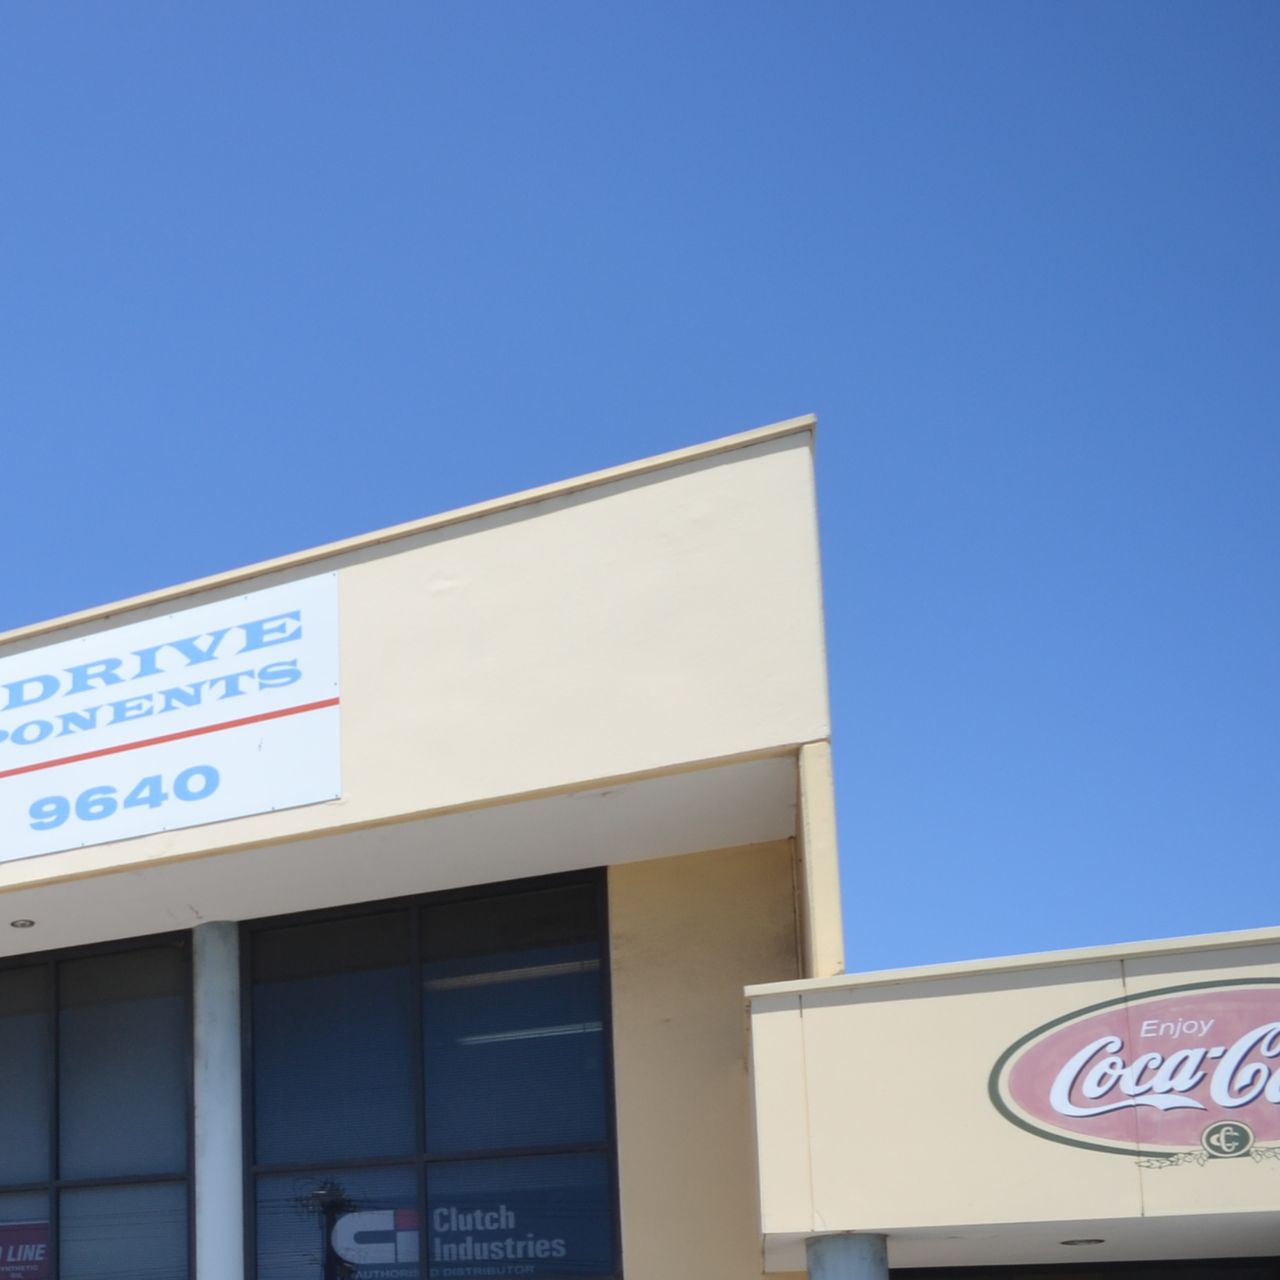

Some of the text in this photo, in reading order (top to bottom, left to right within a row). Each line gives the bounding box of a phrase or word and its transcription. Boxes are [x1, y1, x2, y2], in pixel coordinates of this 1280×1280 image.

[0, 609, 303, 712] DRIVE
[28, 764, 221, 832] 9640
[1140, 1018, 1215, 1040] Enjoy
[433, 1205, 516, 1233] Clutch
[7, 1243, 47, 1262] LINE
[433, 1233, 567, 1262] Industries
[443, 1264, 535, 1278] DISTRIBUTOR
